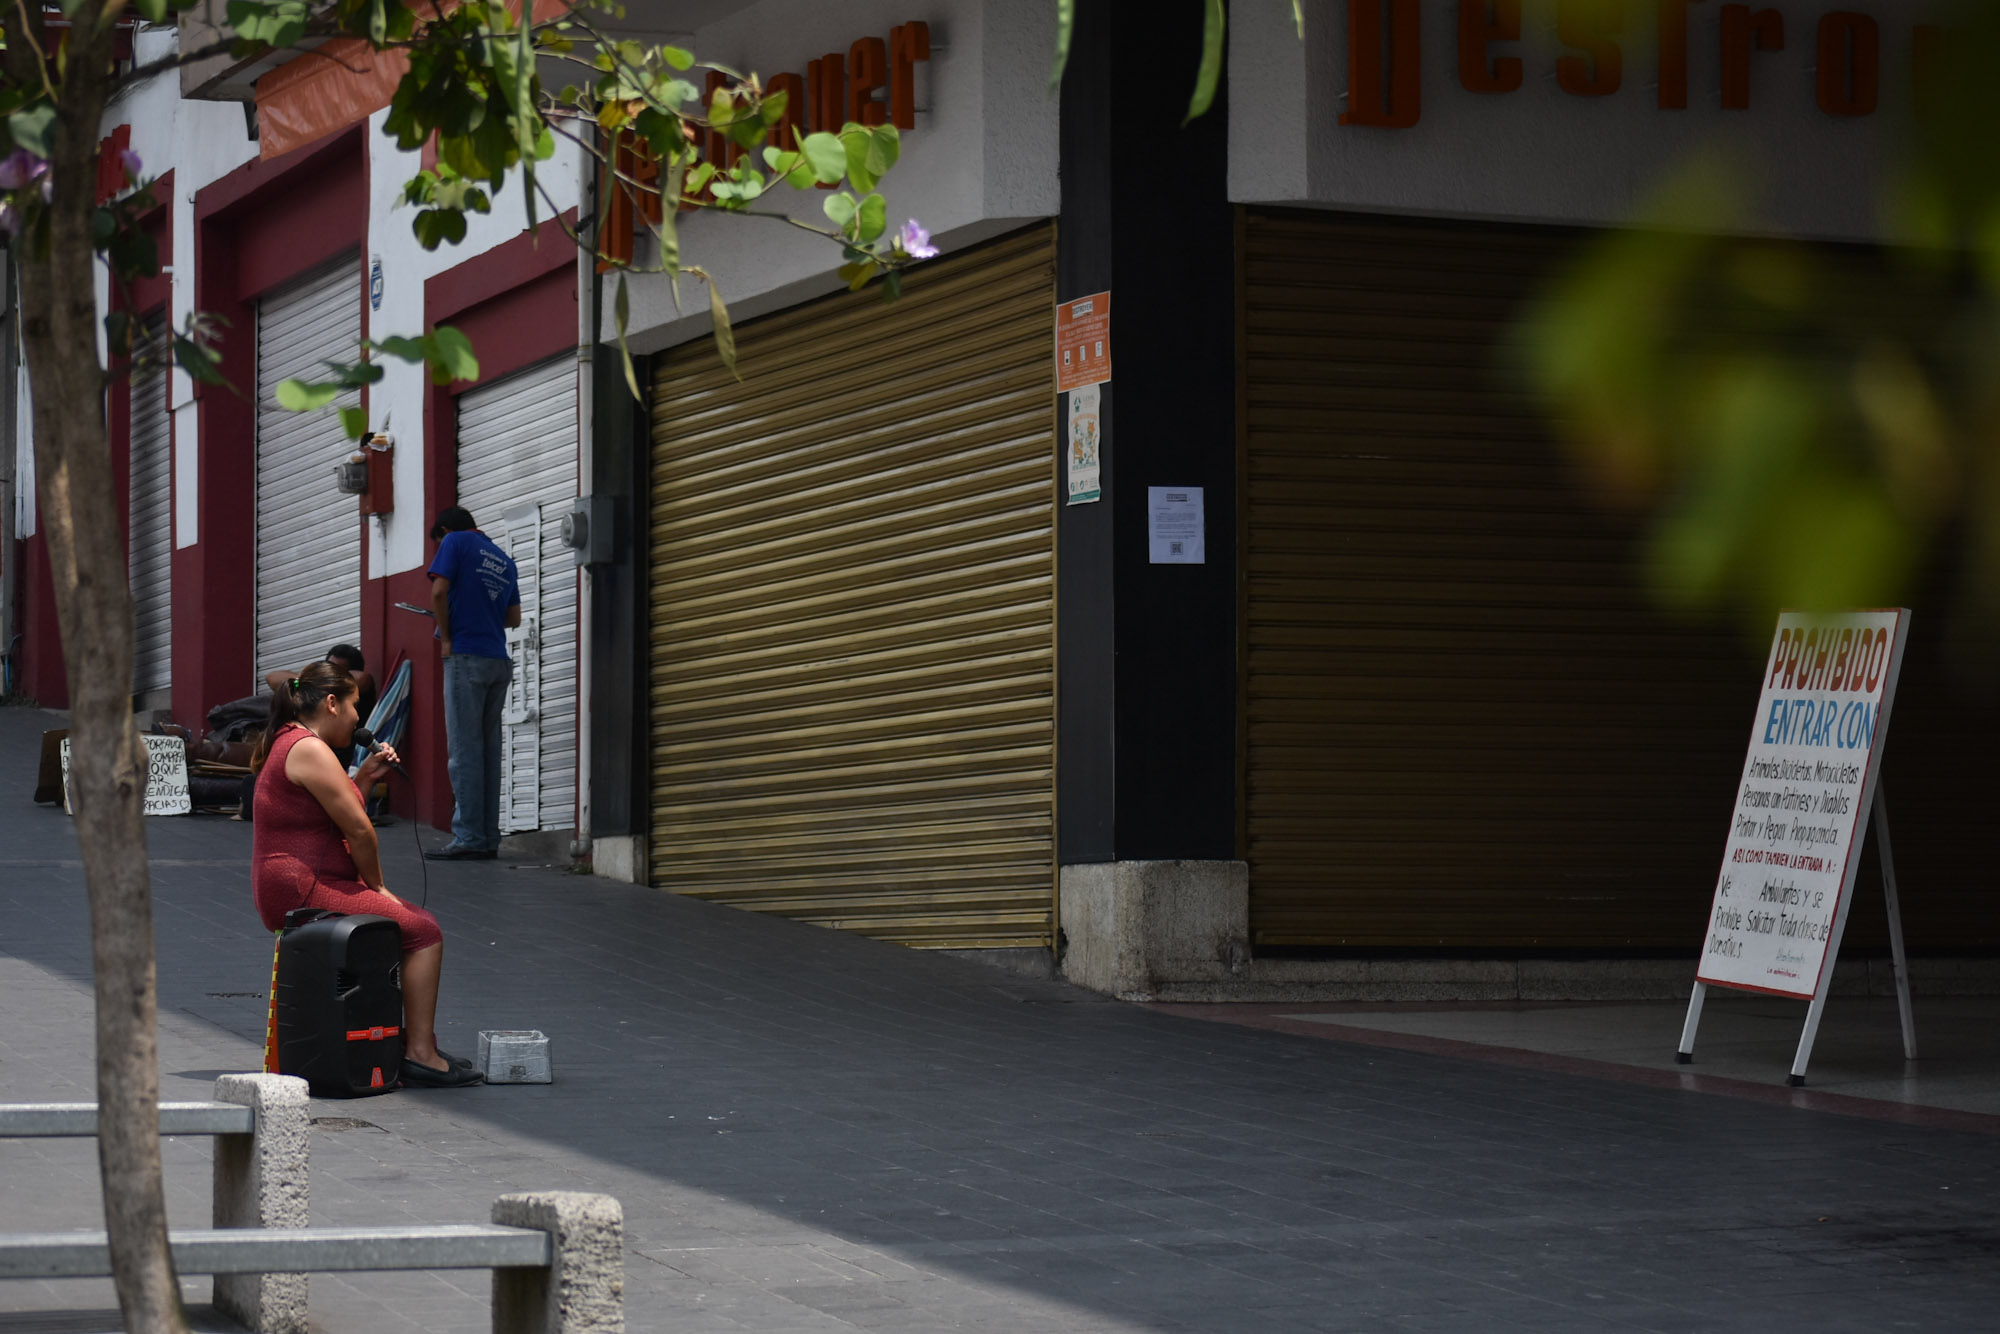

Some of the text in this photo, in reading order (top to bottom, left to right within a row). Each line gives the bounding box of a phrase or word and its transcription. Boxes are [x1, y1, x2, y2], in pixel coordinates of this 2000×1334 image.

[597, 21, 930, 274] Detoyer
[1768, 626, 1887, 693] PROHIBIDO
[1763, 699, 1879, 749] ENTRAR CON
[1813, 760, 1859, 784] Motocicletas
[143, 799, 177, 811] RACIAS
[144, 785, 188, 798] ENDIGA
[1741, 784, 1769, 807] Personas
[1770, 791, 1782, 809] con
[1782, 786, 1811, 812] Patines
[1820, 788, 1850, 815] Diablos
[1735, 813, 1757, 838] Pintar
[1763, 814, 1787, 847] Pegar
[1732, 848, 1745, 863] ASI
[1745, 849, 1764, 864] COMO
[1764, 851, 1790, 867] TAMBIEN
[1789, 854, 1798, 869] LA
[1797, 855, 1824, 872] ENTRADA
[1759, 877, 1800, 906] Ambulantes
[1812, 890, 1824, 908] se
[1714, 906, 1741, 930] Prohibe
[1746, 909, 1776, 934] Solicitar
[1778, 912, 1797, 938] Toda
[1818, 914, 1830, 942] de
